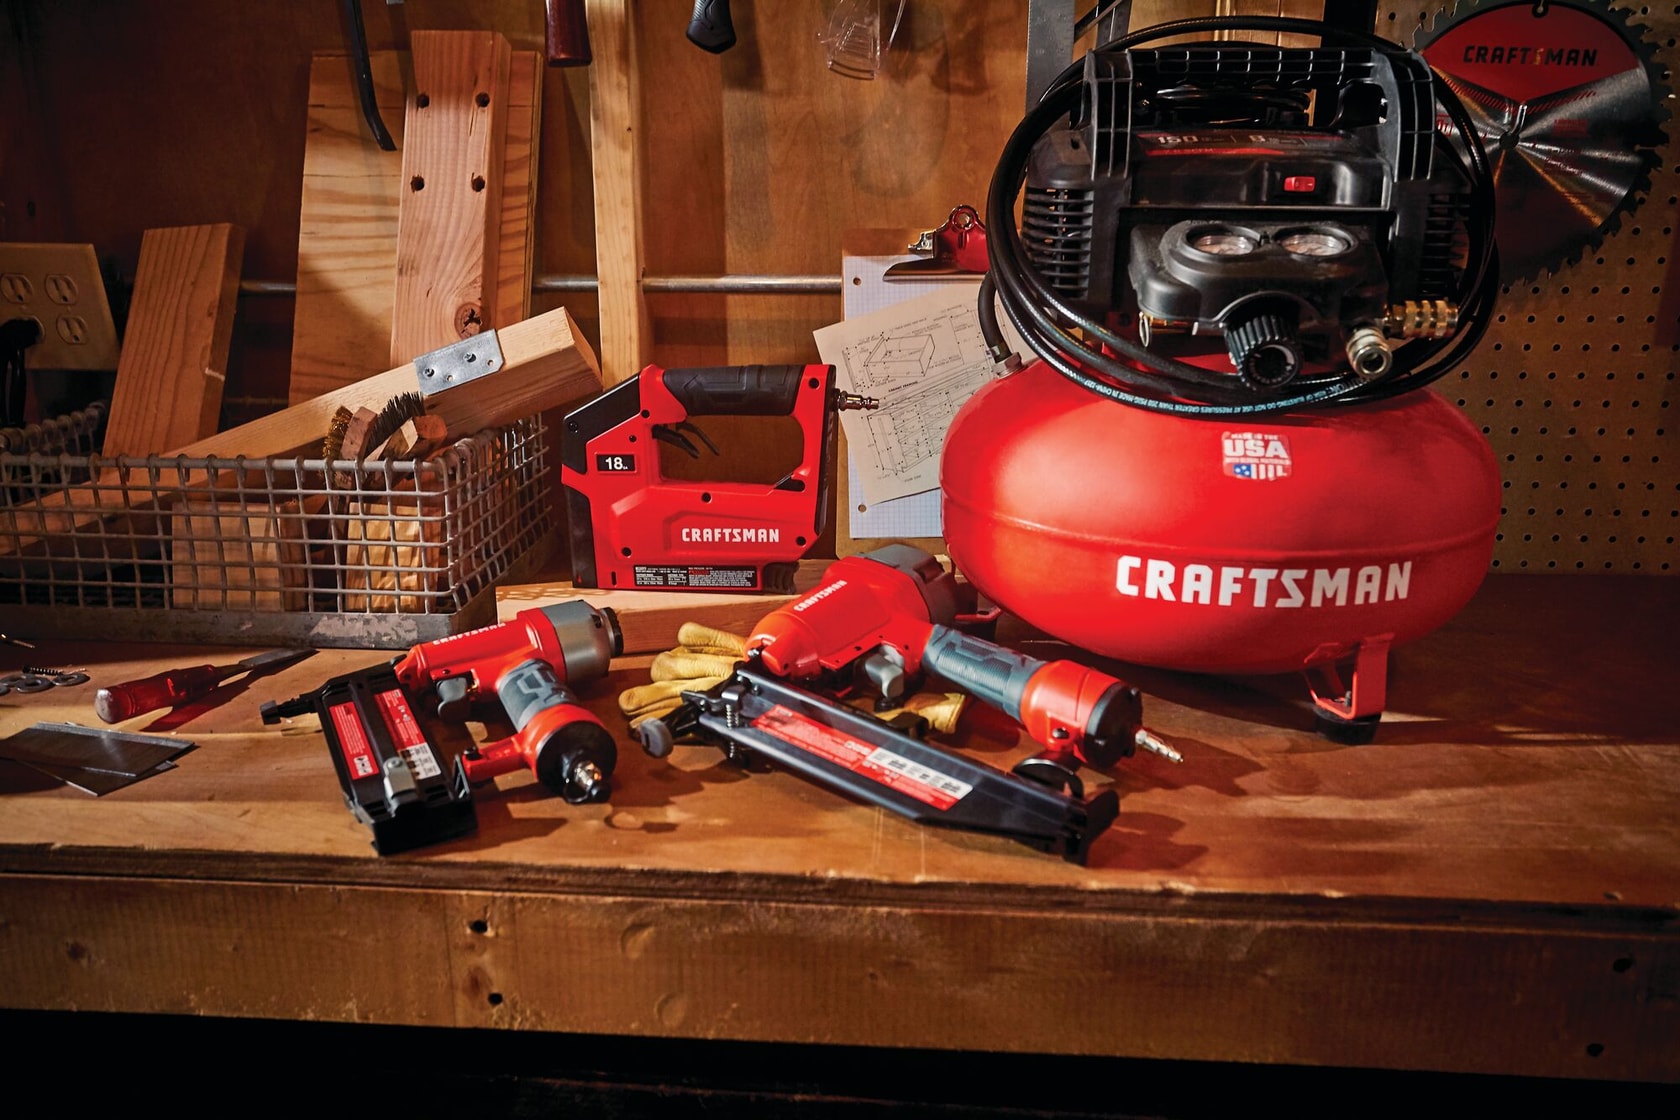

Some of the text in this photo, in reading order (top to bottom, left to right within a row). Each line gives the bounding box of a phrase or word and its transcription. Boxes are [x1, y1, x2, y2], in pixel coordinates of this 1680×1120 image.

[1463, 45, 1599, 67] CRAFTSMAN
[1158, 402, 1174, 410] THAN
[1174, 404, 1200, 413] GREATER
[1242, 405, 1253, 413] USE
[1255, 404, 1266, 412] NOT
[1224, 439, 1289, 459] USA
[605, 456, 623, 470] 18
[681, 528, 780, 543] CRAFTSMAN
[1116, 555, 1413, 608] CRAFTSMAN
[793, 579, 848, 612] CRAFTSMAN
[432, 622, 507, 646] CRAFTSMAN
